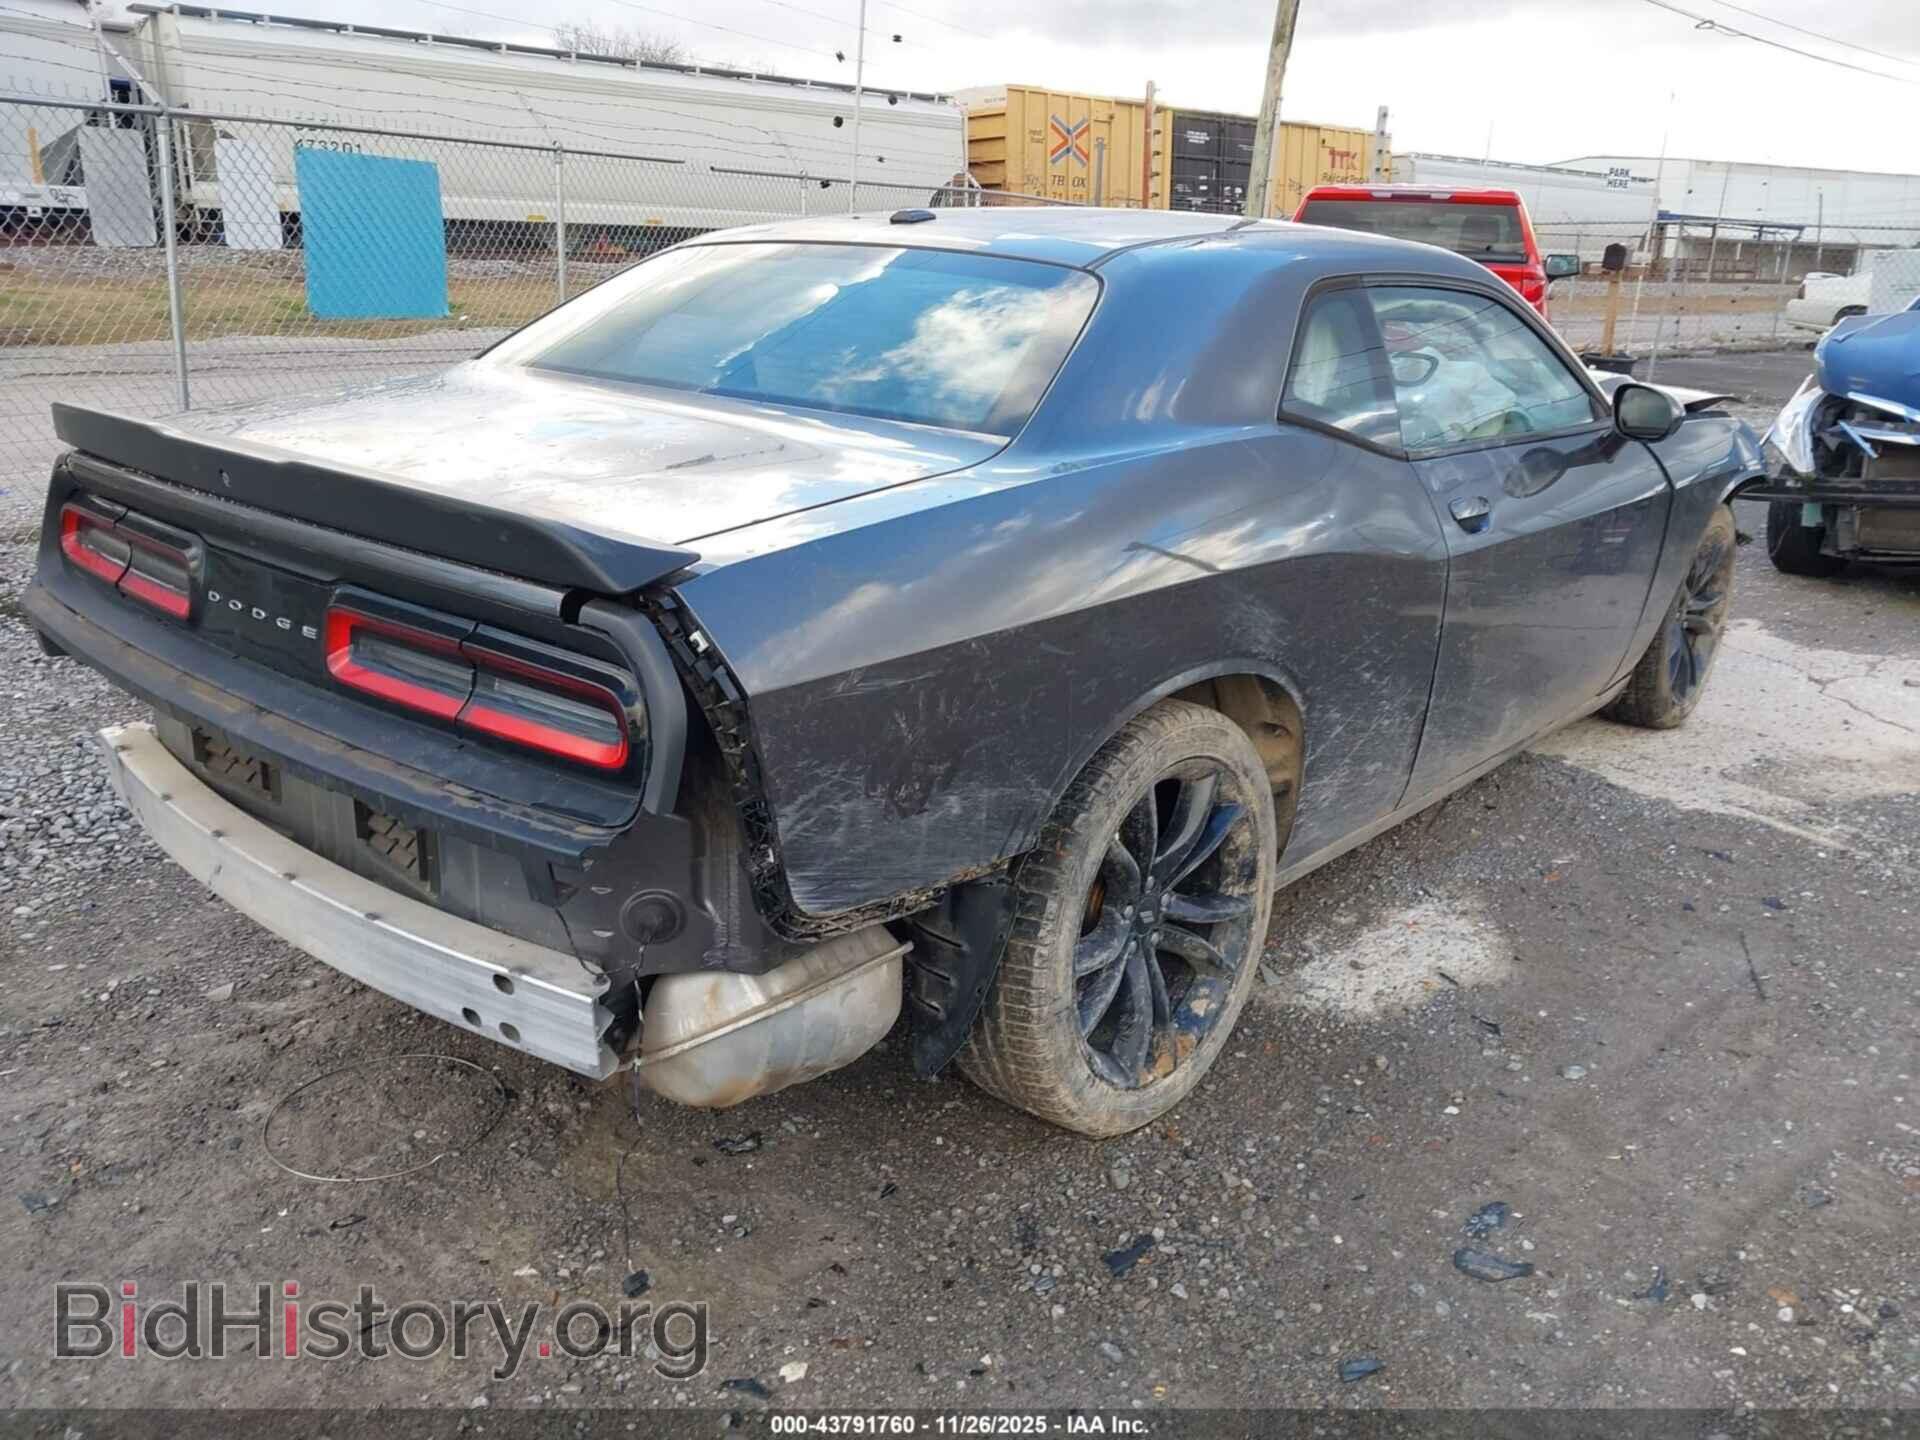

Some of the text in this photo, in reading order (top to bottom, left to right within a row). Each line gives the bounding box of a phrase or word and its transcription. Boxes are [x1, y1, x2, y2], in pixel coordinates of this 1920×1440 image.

[1609, 167, 1630, 177] PARK
[1607, 179, 1629, 189] HERE
[207, 590, 318, 640] DODGE
